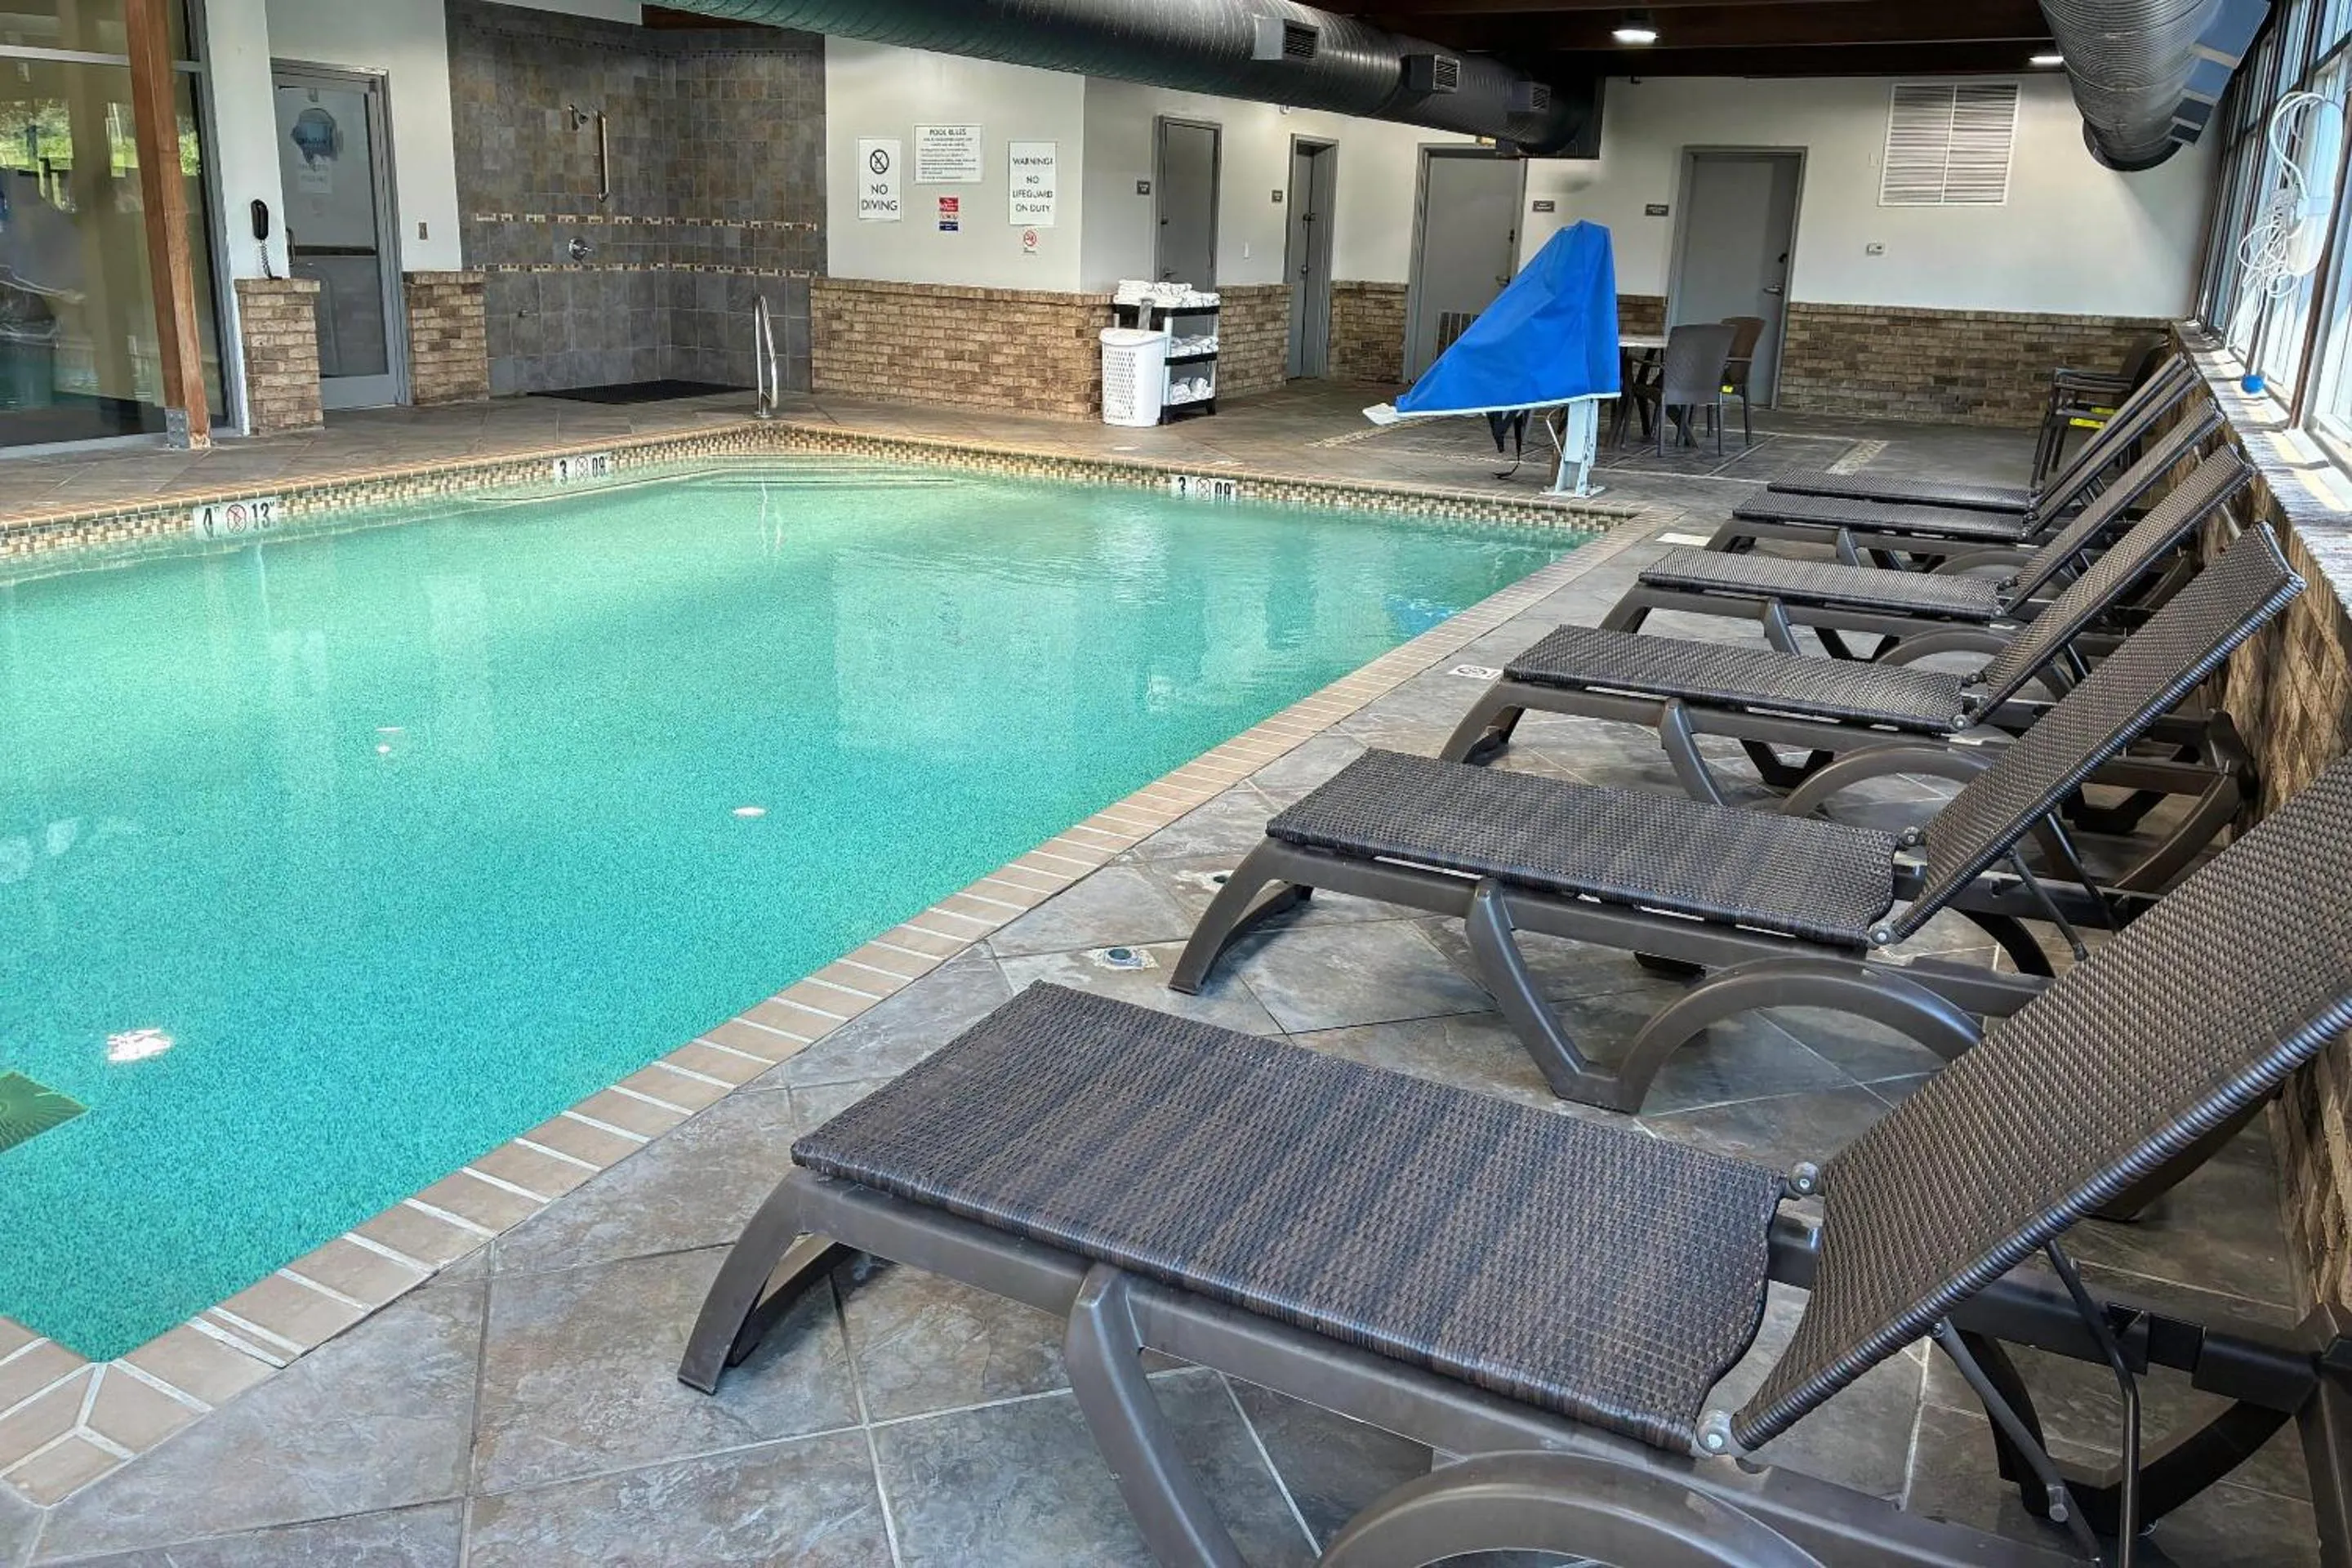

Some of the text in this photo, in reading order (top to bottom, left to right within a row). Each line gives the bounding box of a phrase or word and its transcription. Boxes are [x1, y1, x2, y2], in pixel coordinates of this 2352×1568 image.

[1026, 175, 1040, 184] NO
[871, 184, 889, 195] NO
[1012, 189, 1054, 198] LIFEGUARD
[861, 199, 898, 212] DIVING
[1015, 203, 1052, 212] ON DUTY
